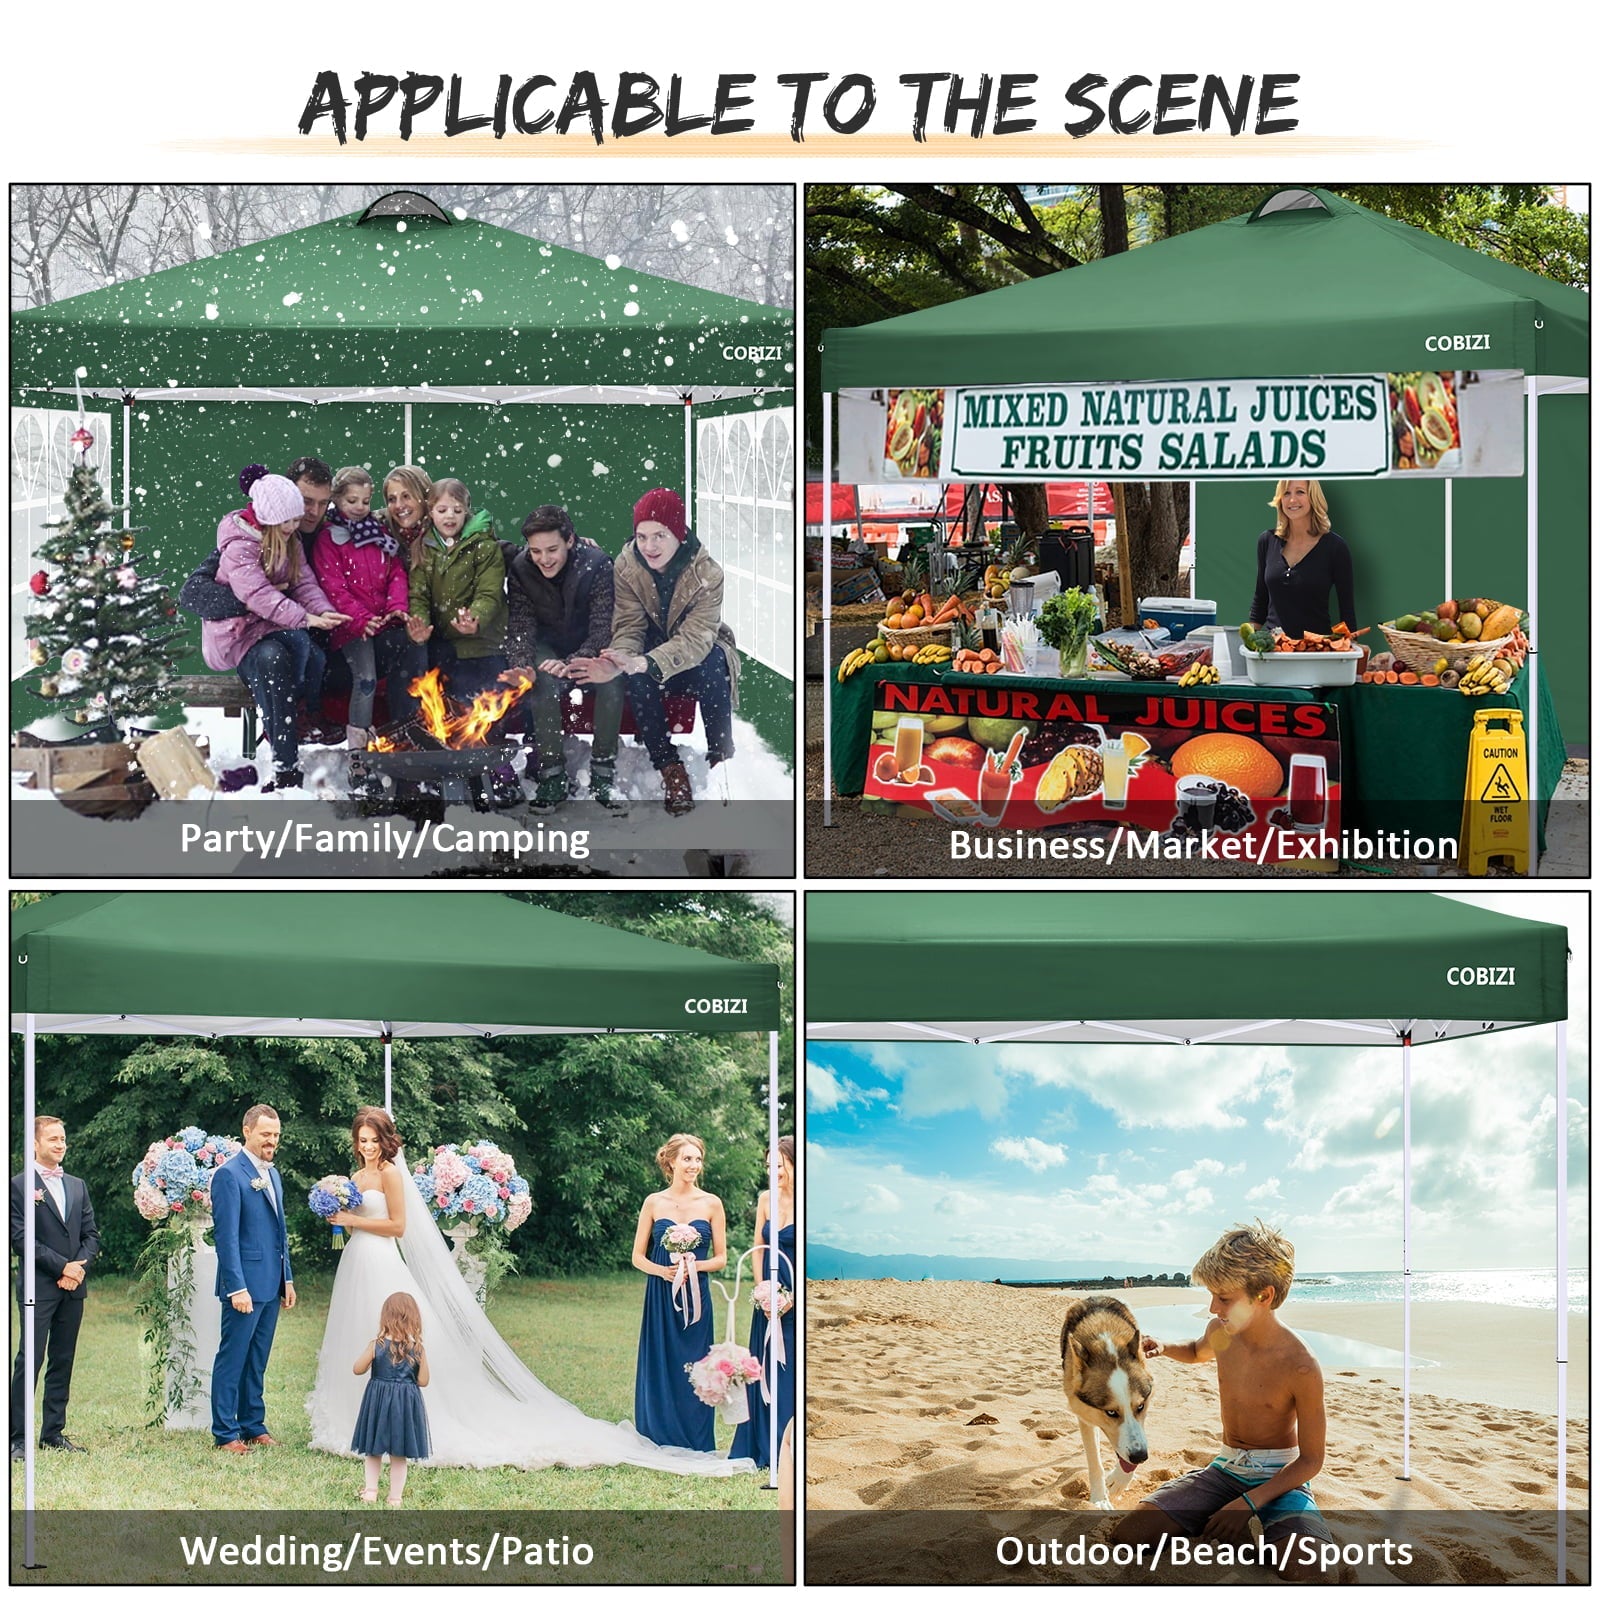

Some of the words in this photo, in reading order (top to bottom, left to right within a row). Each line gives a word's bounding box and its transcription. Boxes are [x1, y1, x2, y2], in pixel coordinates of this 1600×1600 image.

[1425, 335, 1491, 352] COBIZI
[722, 346, 782, 361] COBIZI
[962, 392, 1068, 428] MIXED
[1080, 386, 1238, 427] NATURAL
[1250, 384, 1378, 421] JUICES
[1000, 433, 1143, 470] FRUITS
[1158, 429, 1327, 470] SALADS
[884, 683, 1109, 724] NATURAL
[1135, 696, 1327, 738] JUICES
[1483, 748, 1518, 759] CAUTION
[1494, 806, 1508, 814] WET
[1490, 815, 1512, 823] FLOOR
[1447, 967, 1515, 986] COBIZI
[684, 998, 748, 1014] COBIZI
